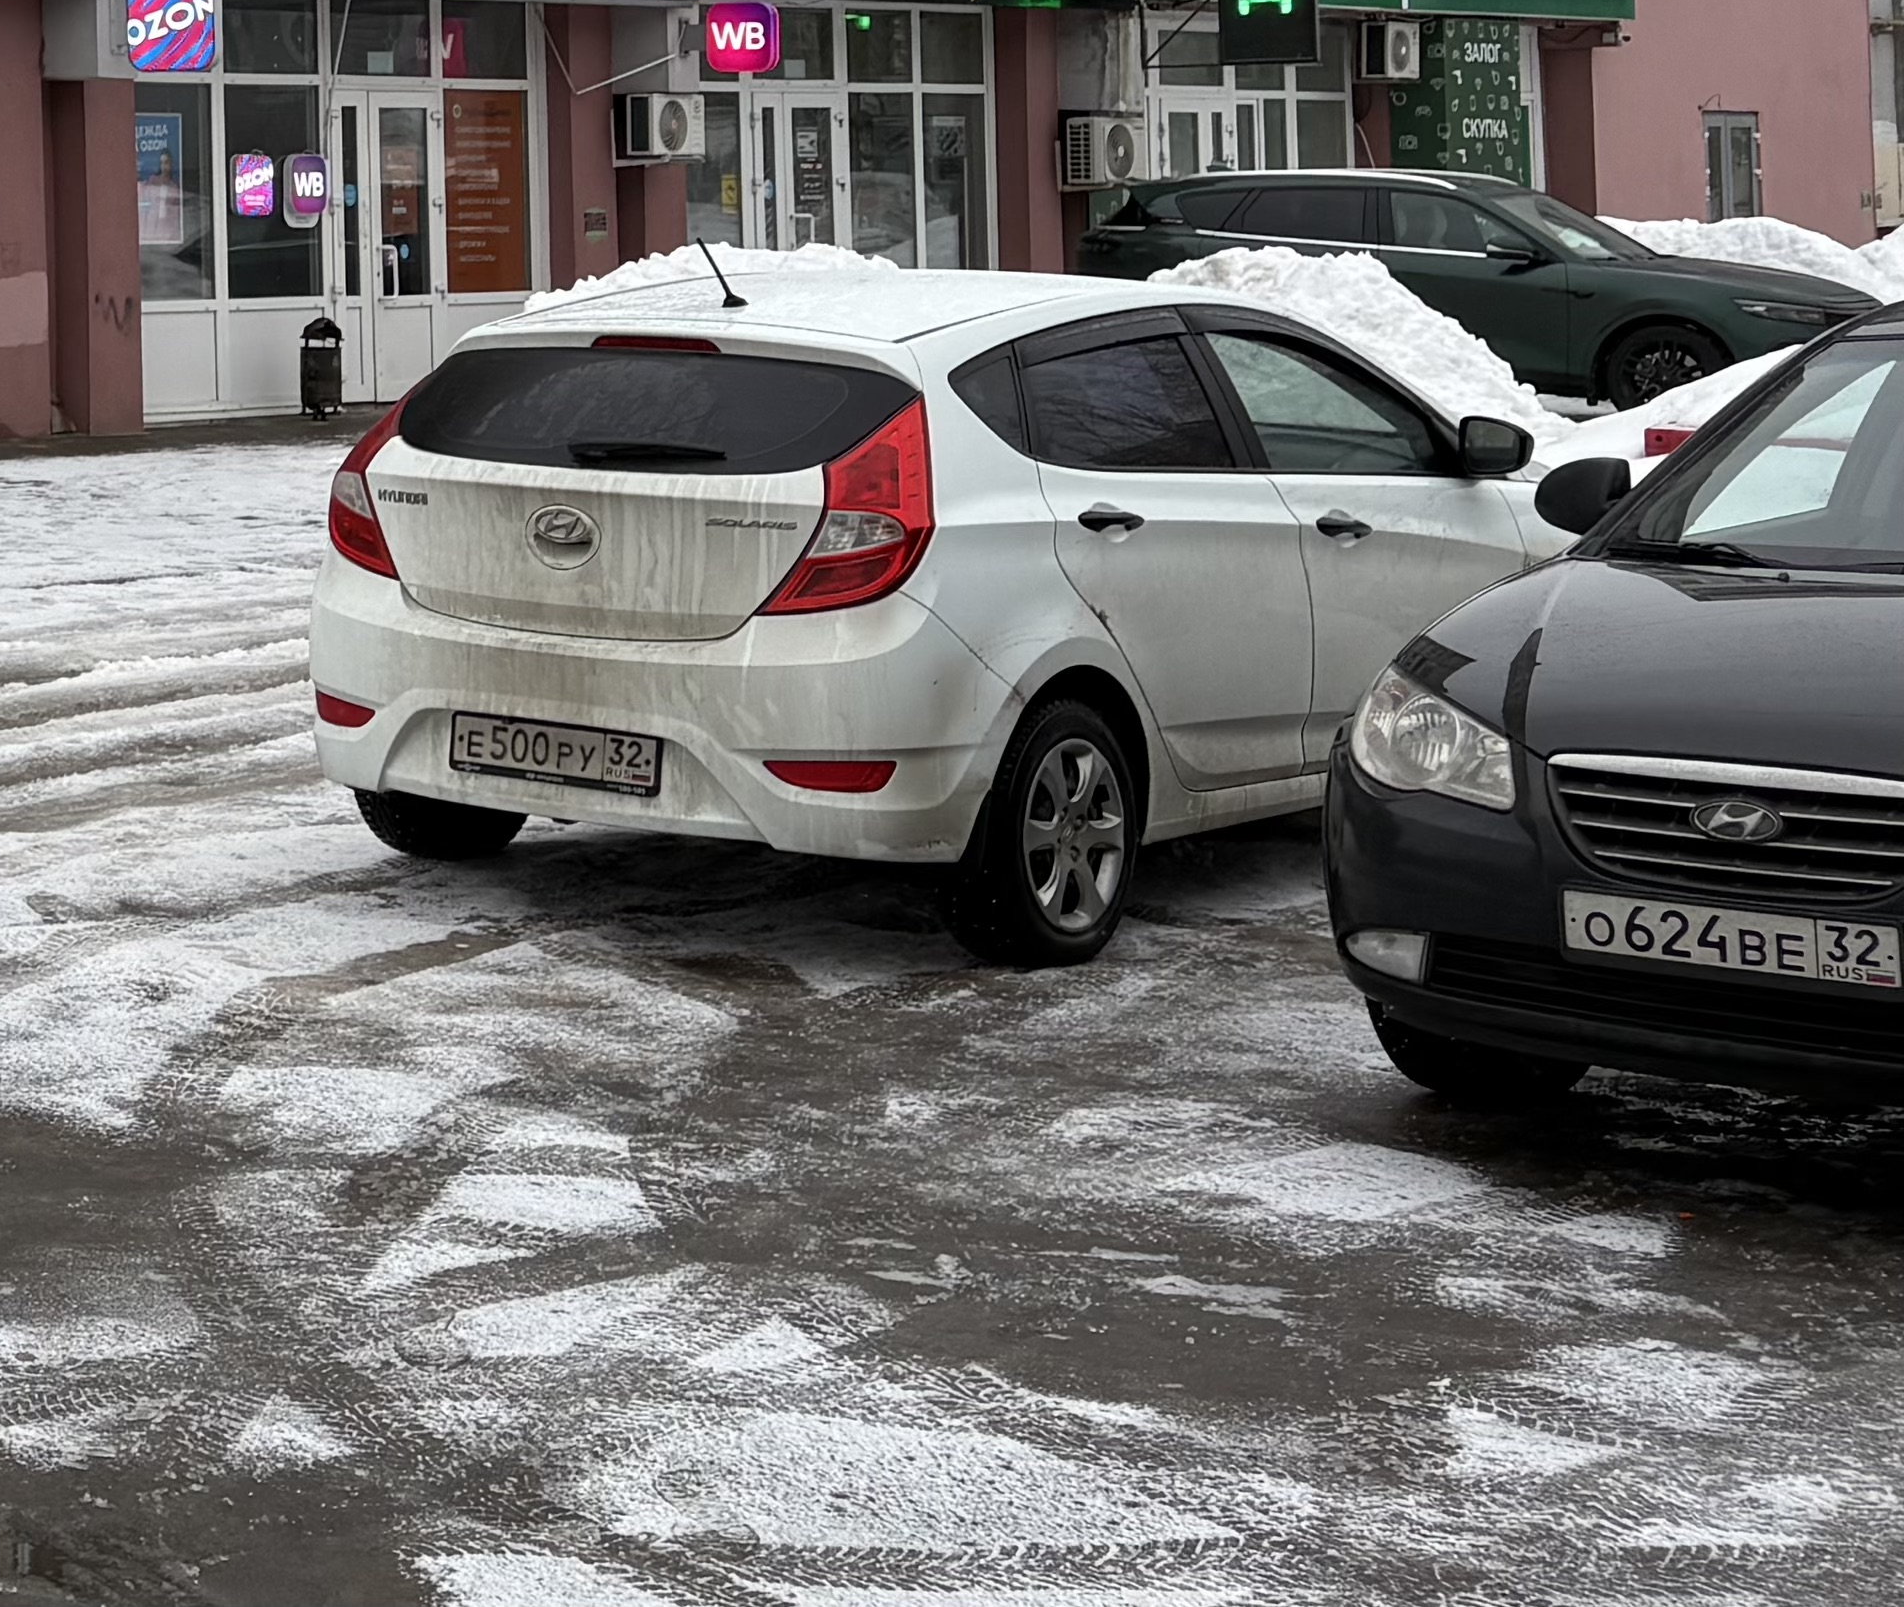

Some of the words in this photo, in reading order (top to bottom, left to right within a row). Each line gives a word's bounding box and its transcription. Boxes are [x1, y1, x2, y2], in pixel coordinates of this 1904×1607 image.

[710, 20, 766, 51] WB
[1463, 41, 1502, 64] ЗАЛОГ
[1462, 117, 1509, 139] СКУПКА
[235, 162, 275, 194] OZON
[293, 171, 325, 198] WB
[705, 517, 797, 530] SOLARIS
[608, 737, 643, 769] 32
[605, 766, 631, 779] RUS
[1823, 925, 1880, 967] 32
[1822, 963, 1864, 982] RUS
